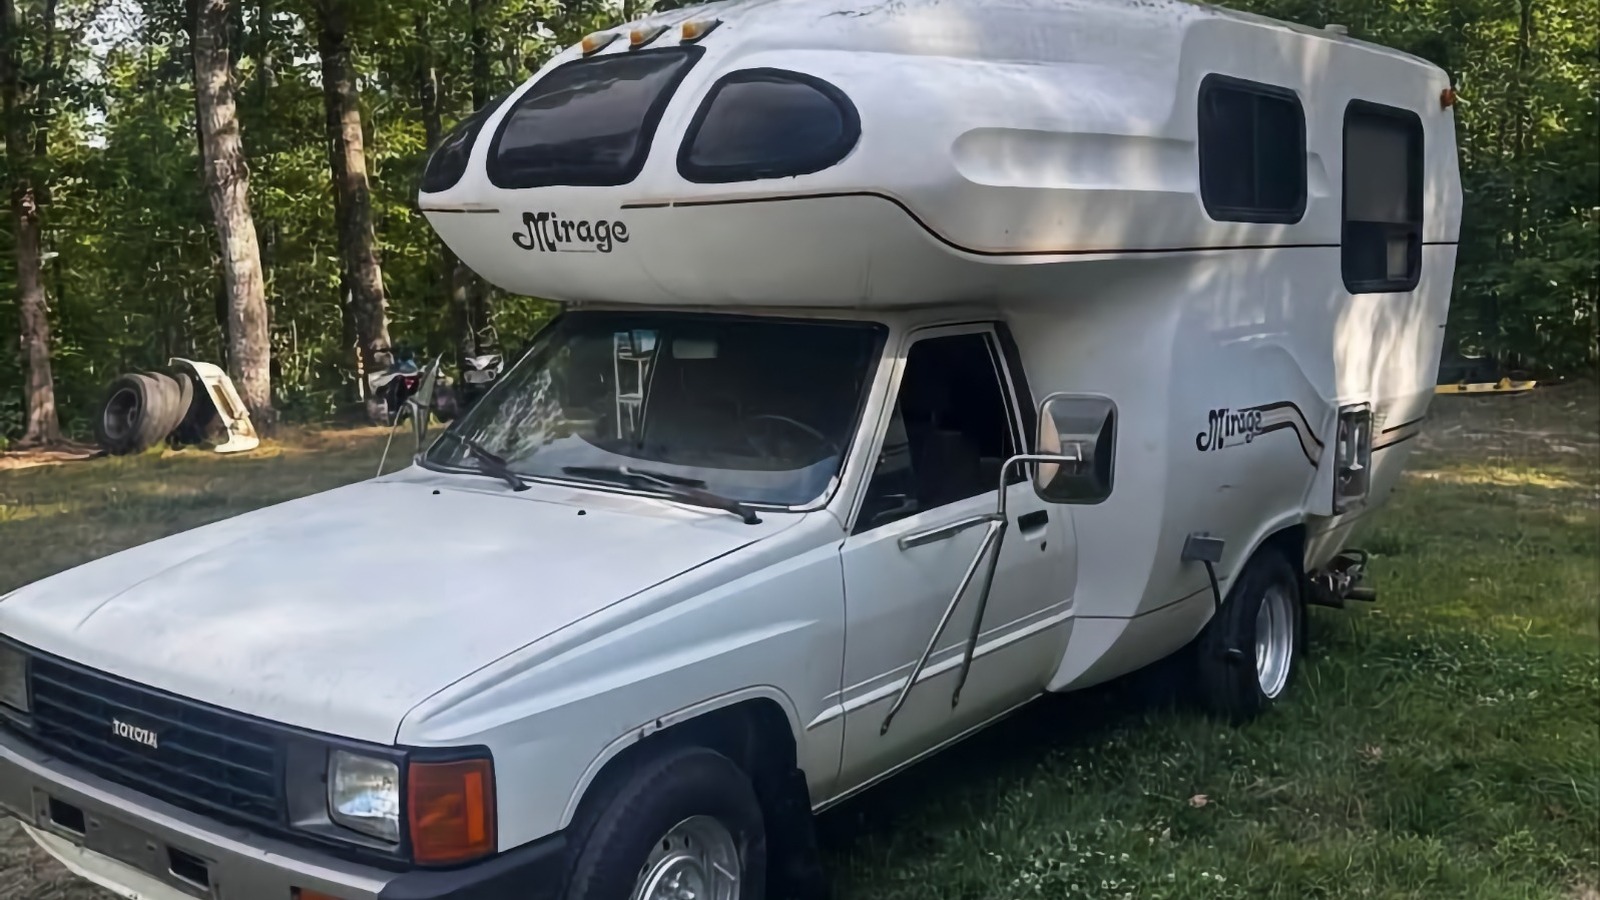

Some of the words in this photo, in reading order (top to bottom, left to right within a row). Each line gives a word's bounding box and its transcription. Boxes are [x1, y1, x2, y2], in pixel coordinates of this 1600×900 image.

[512, 212, 629, 253] Mirage
[1196, 408, 1262, 451] Mirage
[112, 717, 158, 749] TOYOTA
